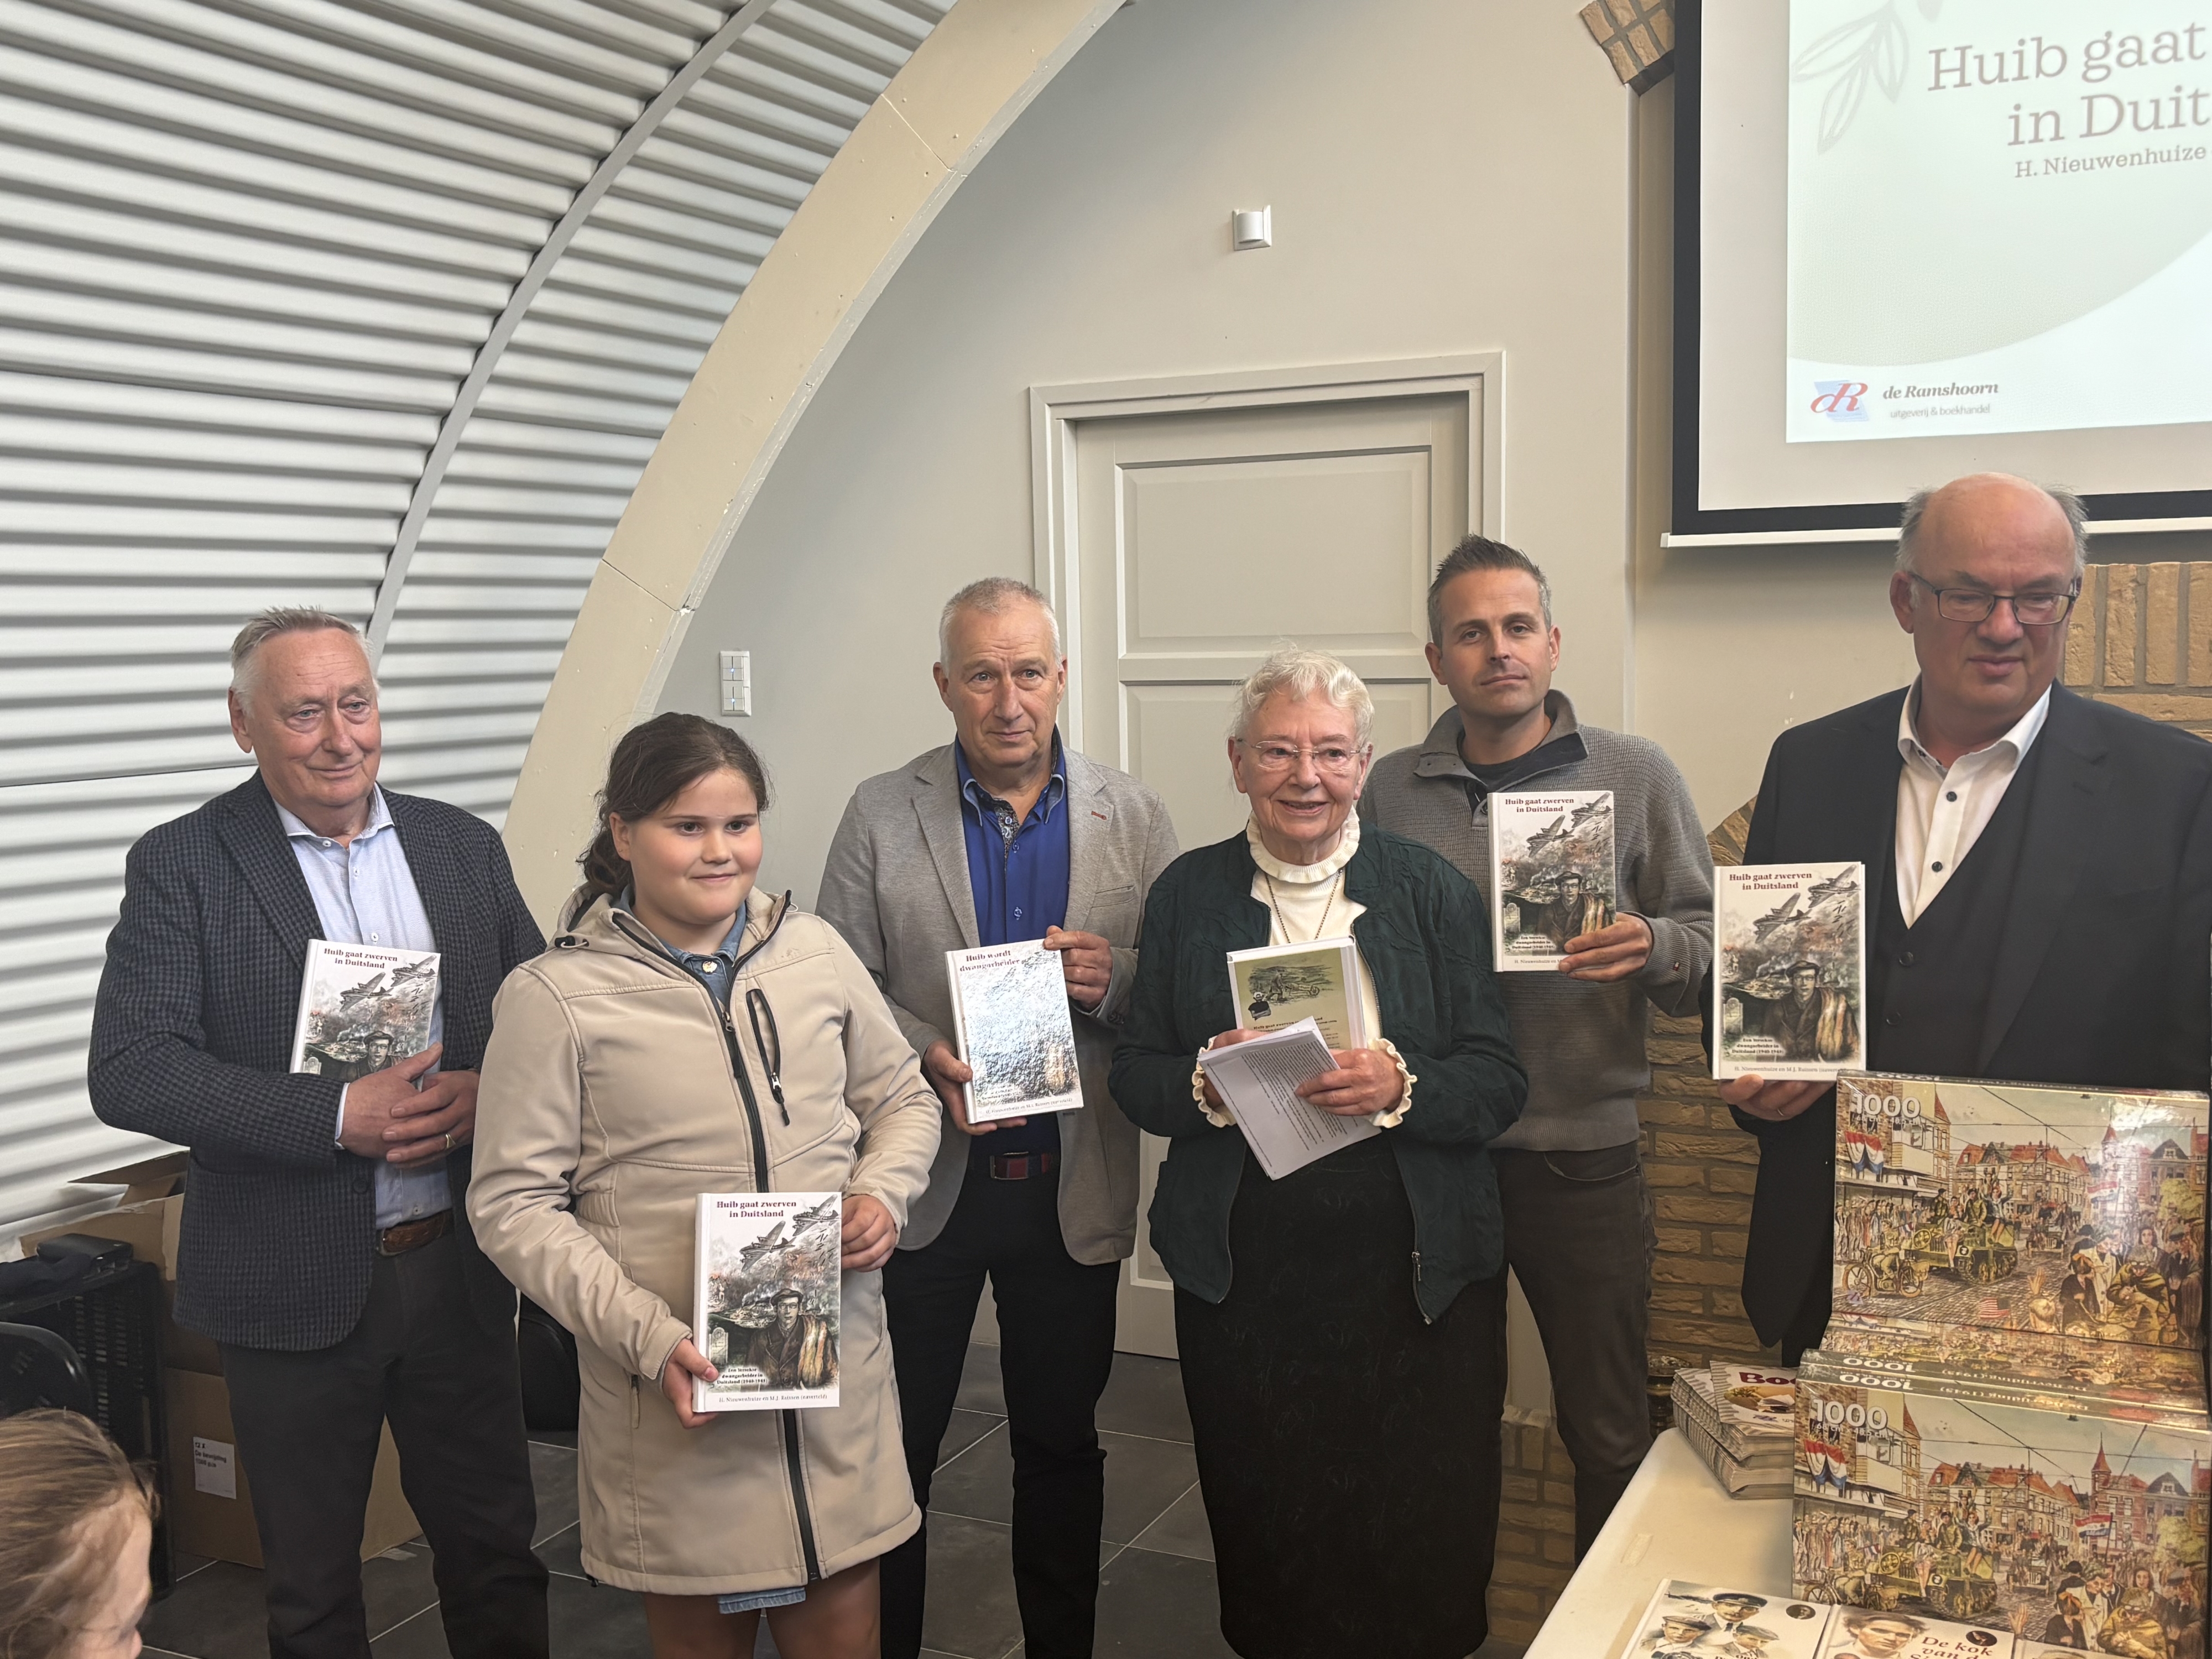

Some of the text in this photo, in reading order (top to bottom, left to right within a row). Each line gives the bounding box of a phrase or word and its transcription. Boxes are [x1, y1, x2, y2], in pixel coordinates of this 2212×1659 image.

[1928, 22, 2206, 91] Huib gaat
[2007, 85, 2211, 146] in Duit
[2015, 145, 2206, 178] H. Nieuwenhuize
[1882, 383, 1999, 399] de Ramshoorn
[1890, 406, 1929, 419] uitgeverij
[1939, 404, 1990, 415] boekhandel
[1753, 873, 1772, 881] gaat
[324, 948, 344, 956] Huib
[364, 953, 398, 962] zwerven
[966, 950, 1011, 962] Huib wordt
[345, 959, 385, 969] Duitsland
[959, 958, 1020, 972] dwangarbeider
[1852, 1093, 1921, 1118] 1000
[740, 1201, 758, 1209] gaat
[1843, 1358, 1916, 1373] 1000
[1839, 1374, 1913, 1390] 1000
[1940, 1386, 1984, 1396] (1945)
[1813, 1399, 1888, 1430] 1000
[1922, 1637, 1993, 1656] De kok
[1922, 1648, 1959, 1659] van
